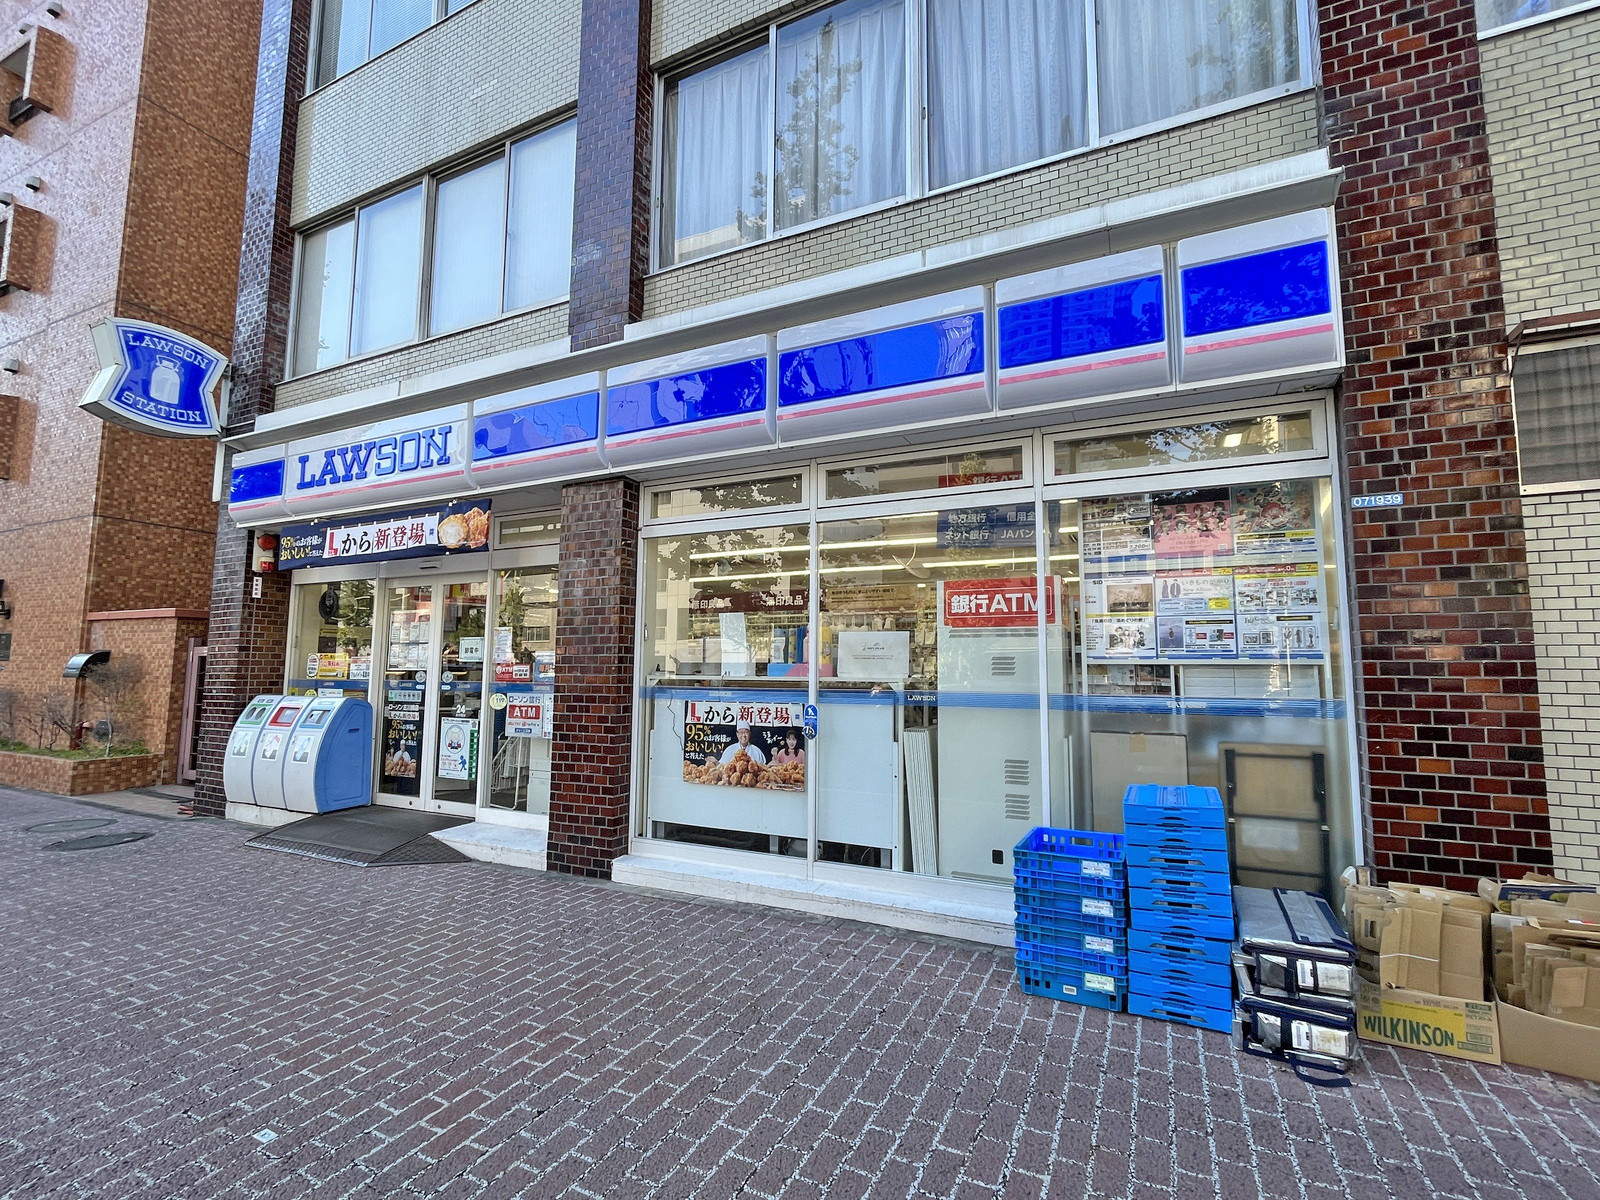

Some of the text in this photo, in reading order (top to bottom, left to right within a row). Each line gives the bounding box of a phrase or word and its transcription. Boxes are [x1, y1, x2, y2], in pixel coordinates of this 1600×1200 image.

[127, 334, 209, 369] LAWSON
[122, 391, 202, 423] STATION
[297, 425, 451, 490] LAWSON
[1353, 494, 1401, 507] 071939
[1007, 511, 1036, 522] 信用金
[1001, 528, 1035, 539] JAバン
[766, 595, 804, 606] 無印良品
[514, 706, 536, 718] ATM
[685, 741, 725, 754] おいしい!
[1364, 1015, 1455, 1047] WILKINSON
